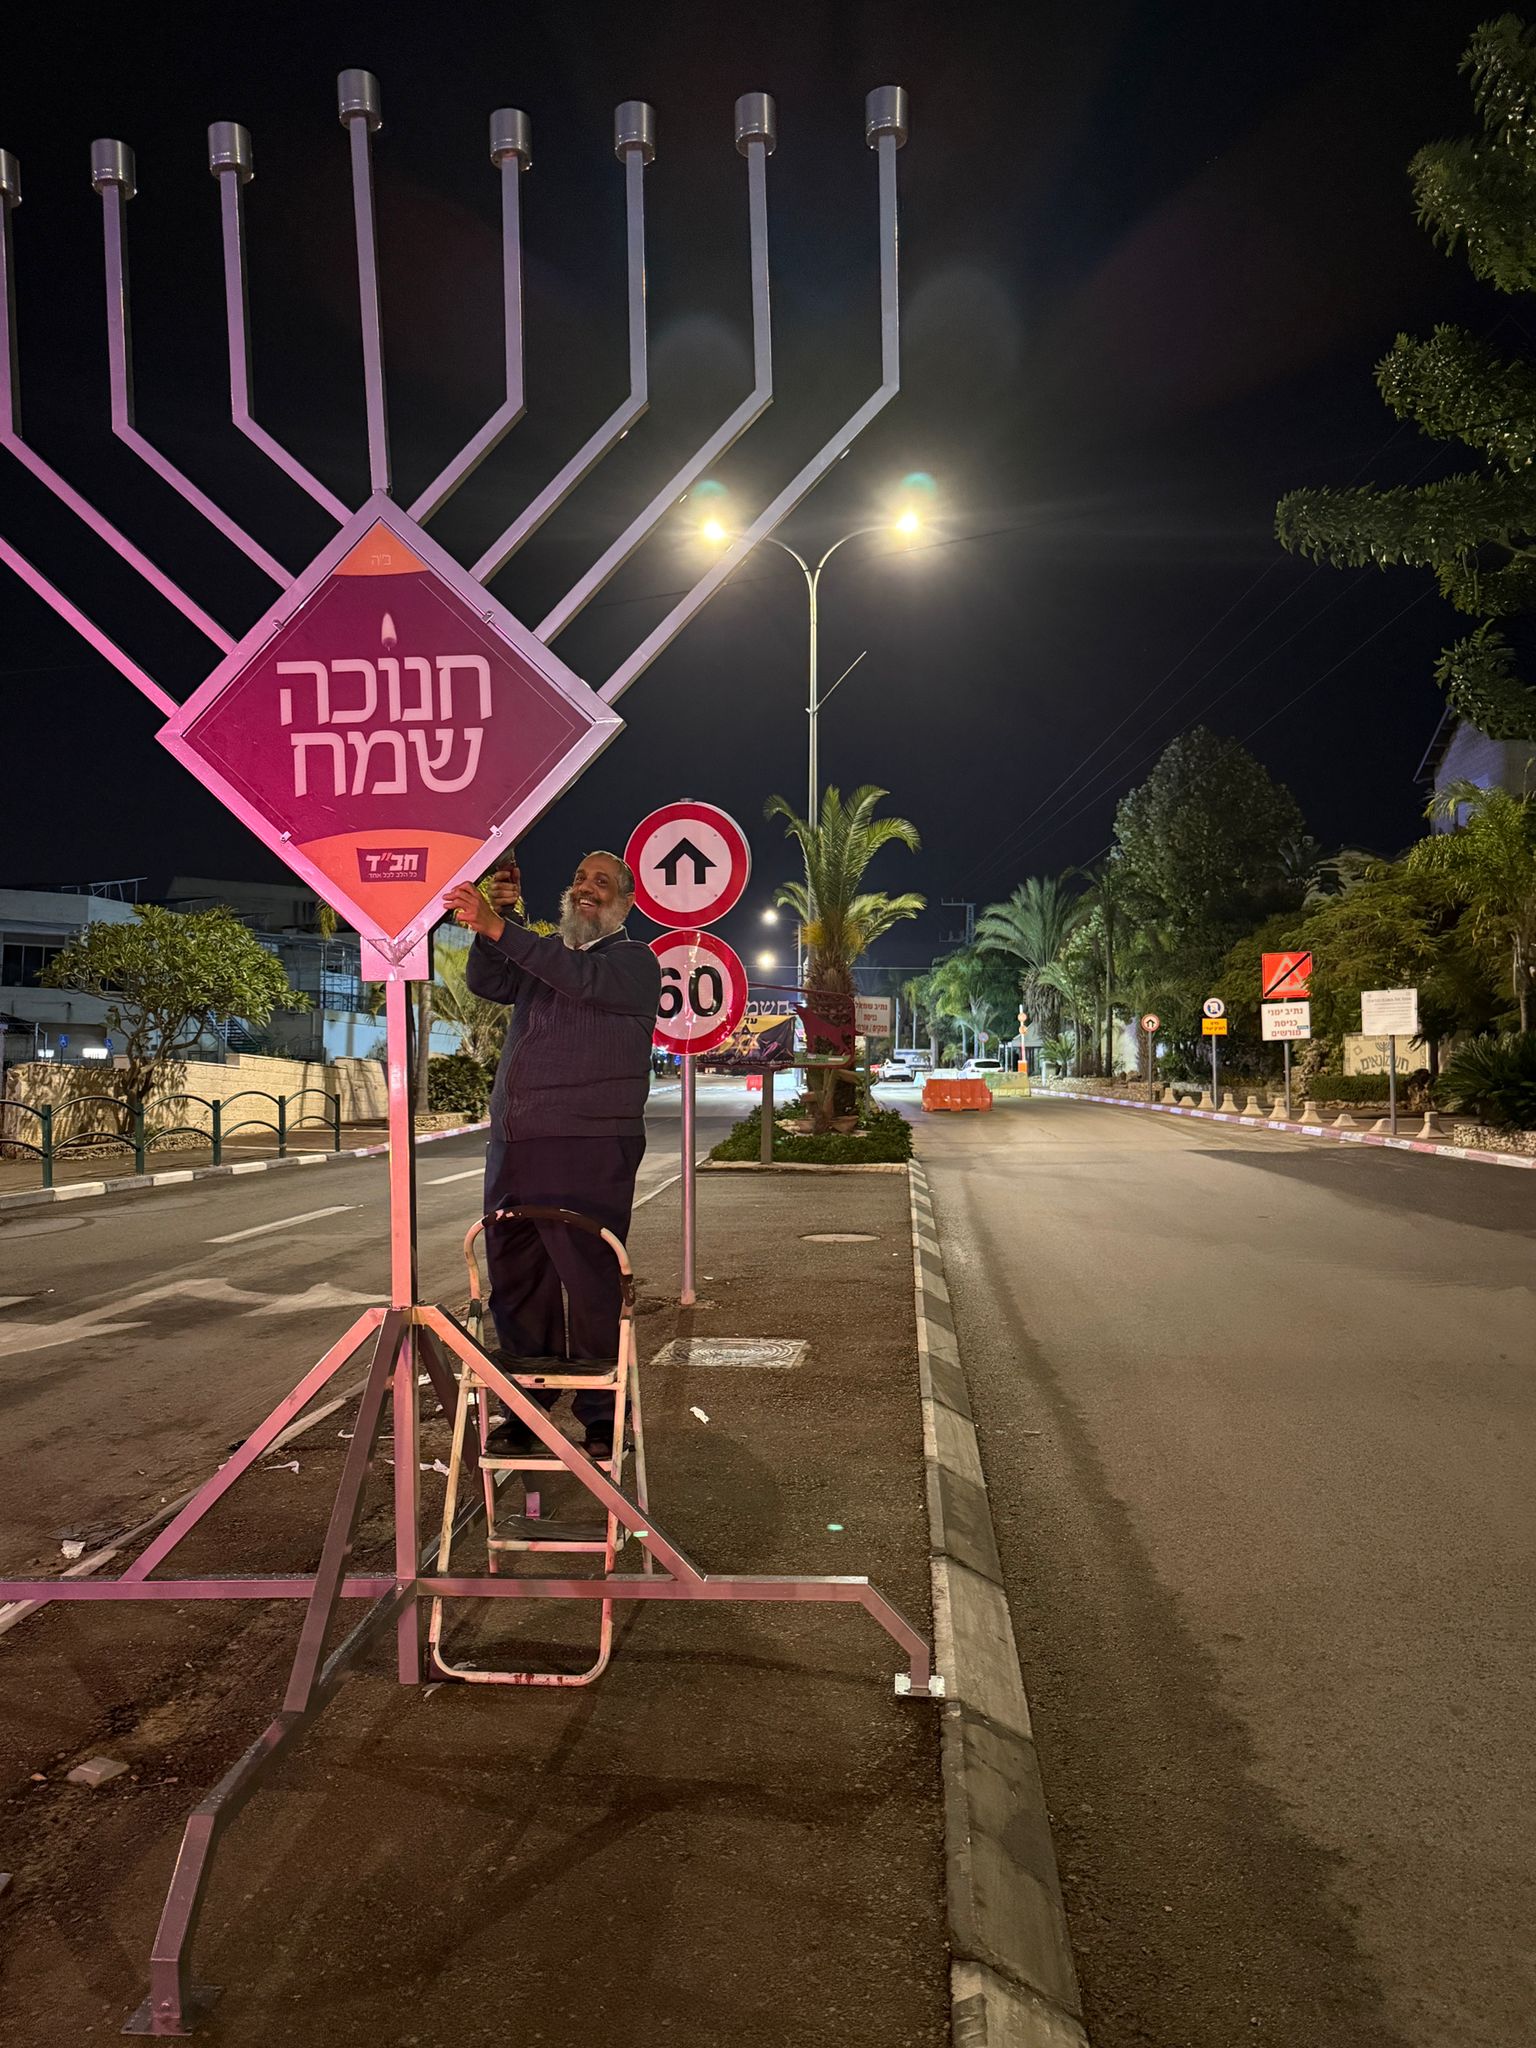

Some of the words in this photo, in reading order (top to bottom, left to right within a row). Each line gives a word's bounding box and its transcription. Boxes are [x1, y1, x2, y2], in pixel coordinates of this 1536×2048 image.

[276, 654, 493, 727] חנוכה
[290, 727, 484, 798] שמח
[656, 966, 723, 1019] 60
[1268, 1008, 1283, 1016] ימני
[1285, 1007, 1303, 1015] נתיב
[1274, 1019, 1298, 1028] כניסת
[1271, 1029, 1302, 1037] מורשים
